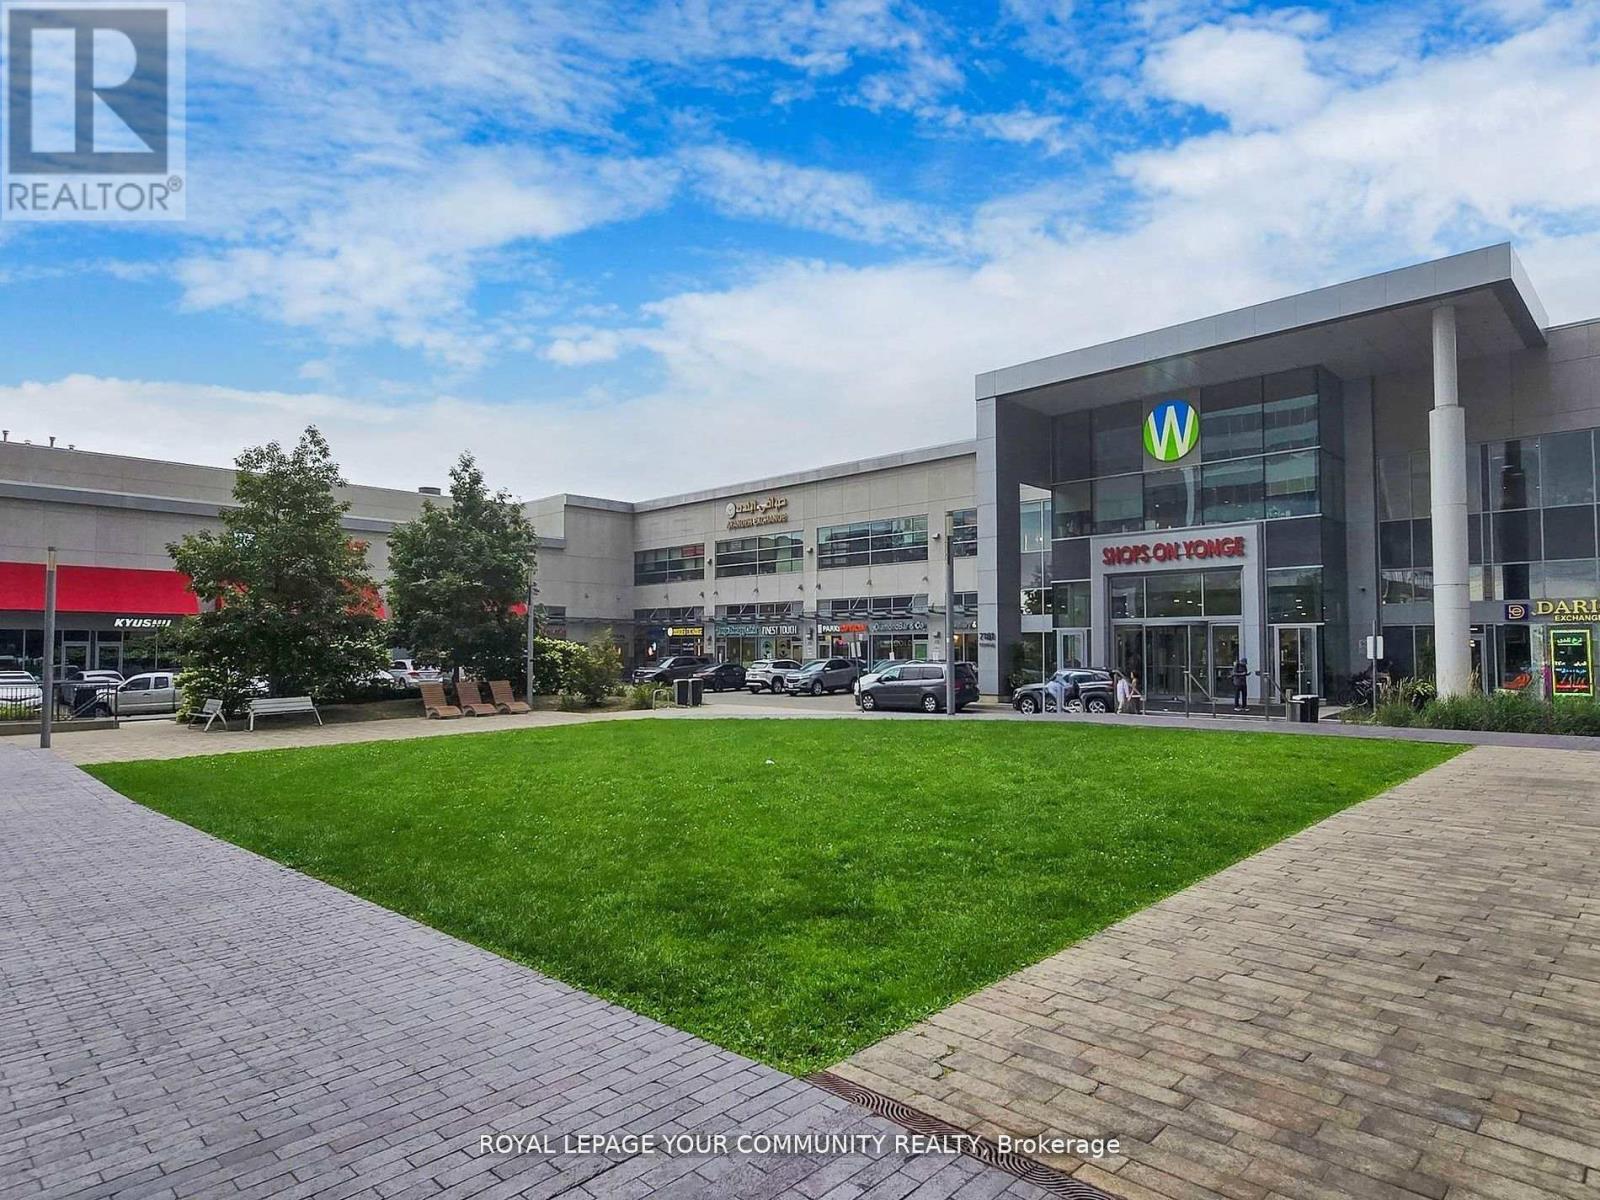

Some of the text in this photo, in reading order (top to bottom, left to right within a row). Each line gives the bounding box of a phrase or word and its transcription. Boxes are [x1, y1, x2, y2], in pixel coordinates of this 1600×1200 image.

[1148, 405, 1195, 460] W
[1103, 536, 1246, 565] SHOPS ON YONGE
[1532, 599, 1600, 616] DARI
[762, 625, 778, 635] FINEST
[779, 625, 797, 635] TOUCH
